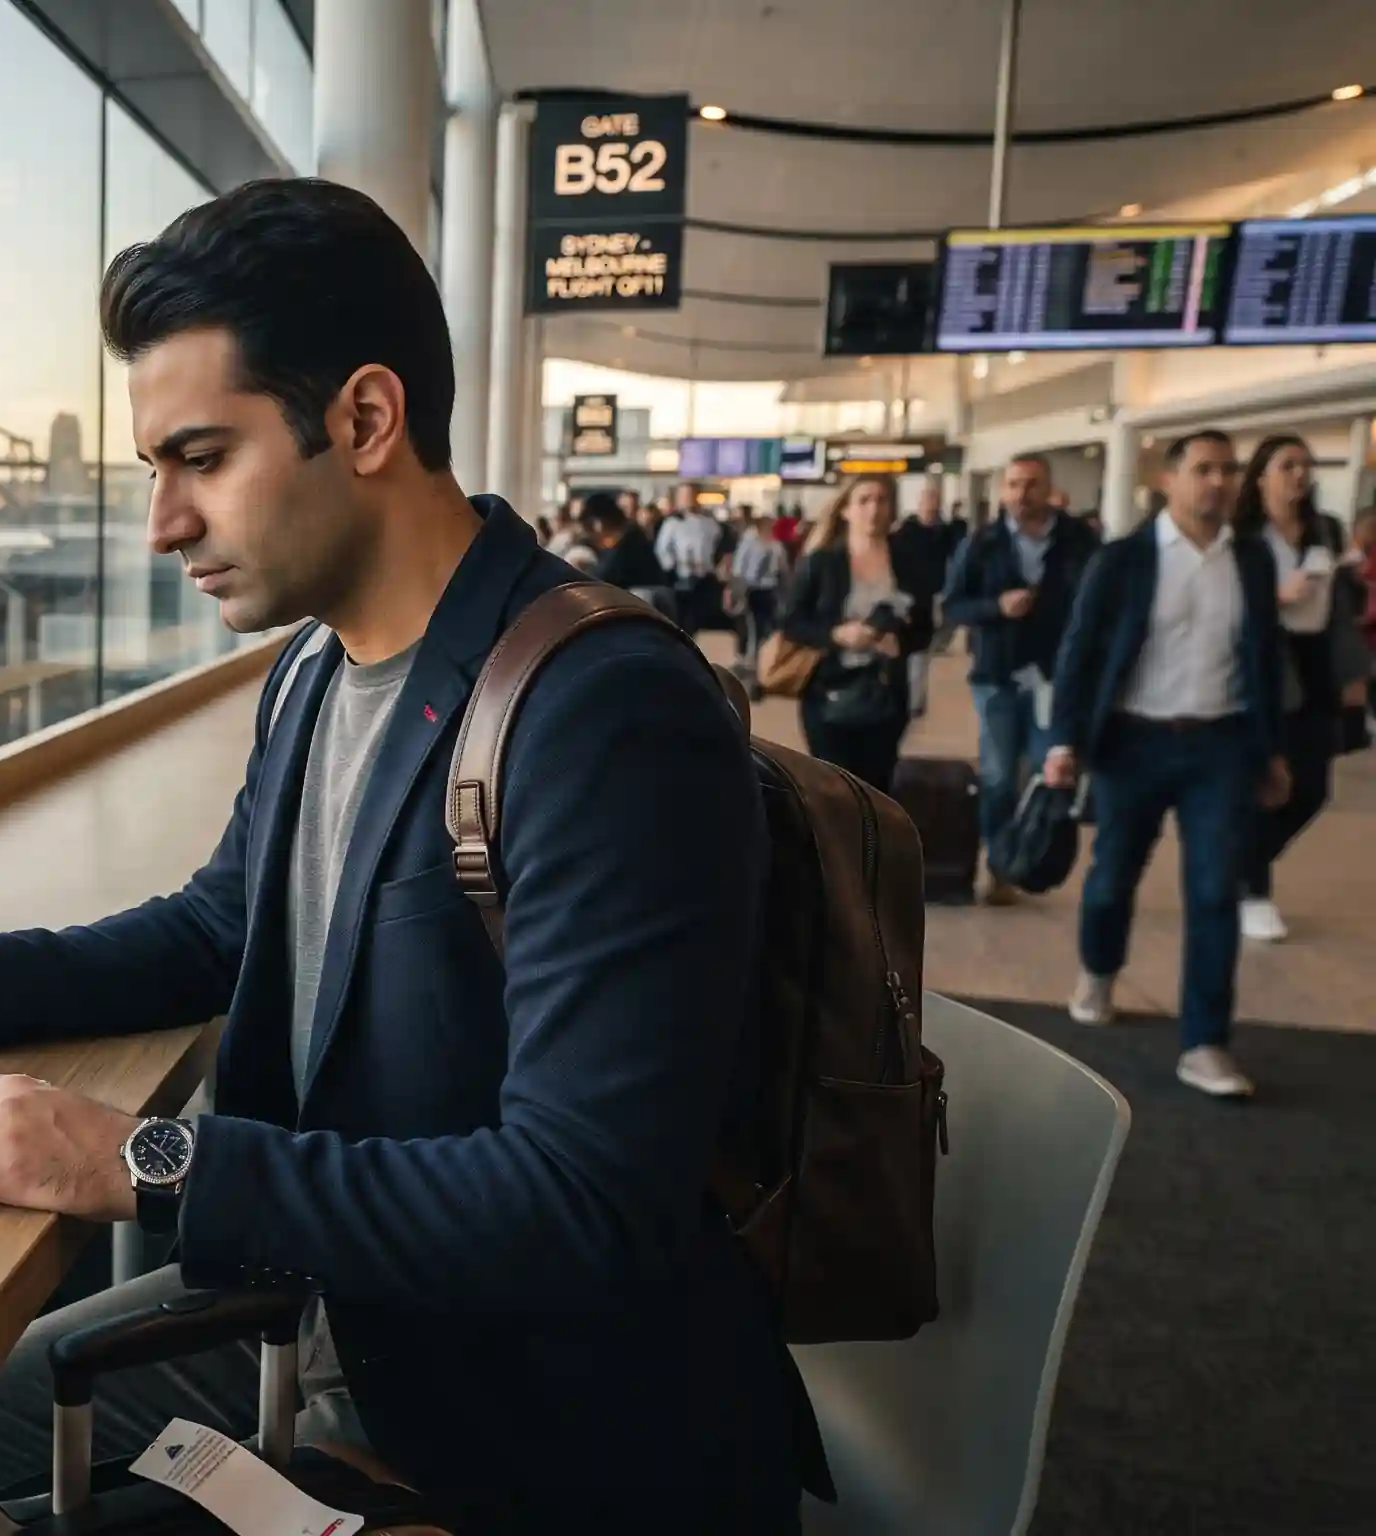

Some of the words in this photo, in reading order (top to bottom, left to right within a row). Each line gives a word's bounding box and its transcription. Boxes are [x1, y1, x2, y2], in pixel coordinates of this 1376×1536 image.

[581, 113, 639, 138] GATE
[554, 140, 667, 195] B52
[560, 232, 641, 256] SYDNEY
[545, 253, 667, 277] MELBOURNE
[546, 276, 615, 298] FLIGHT
